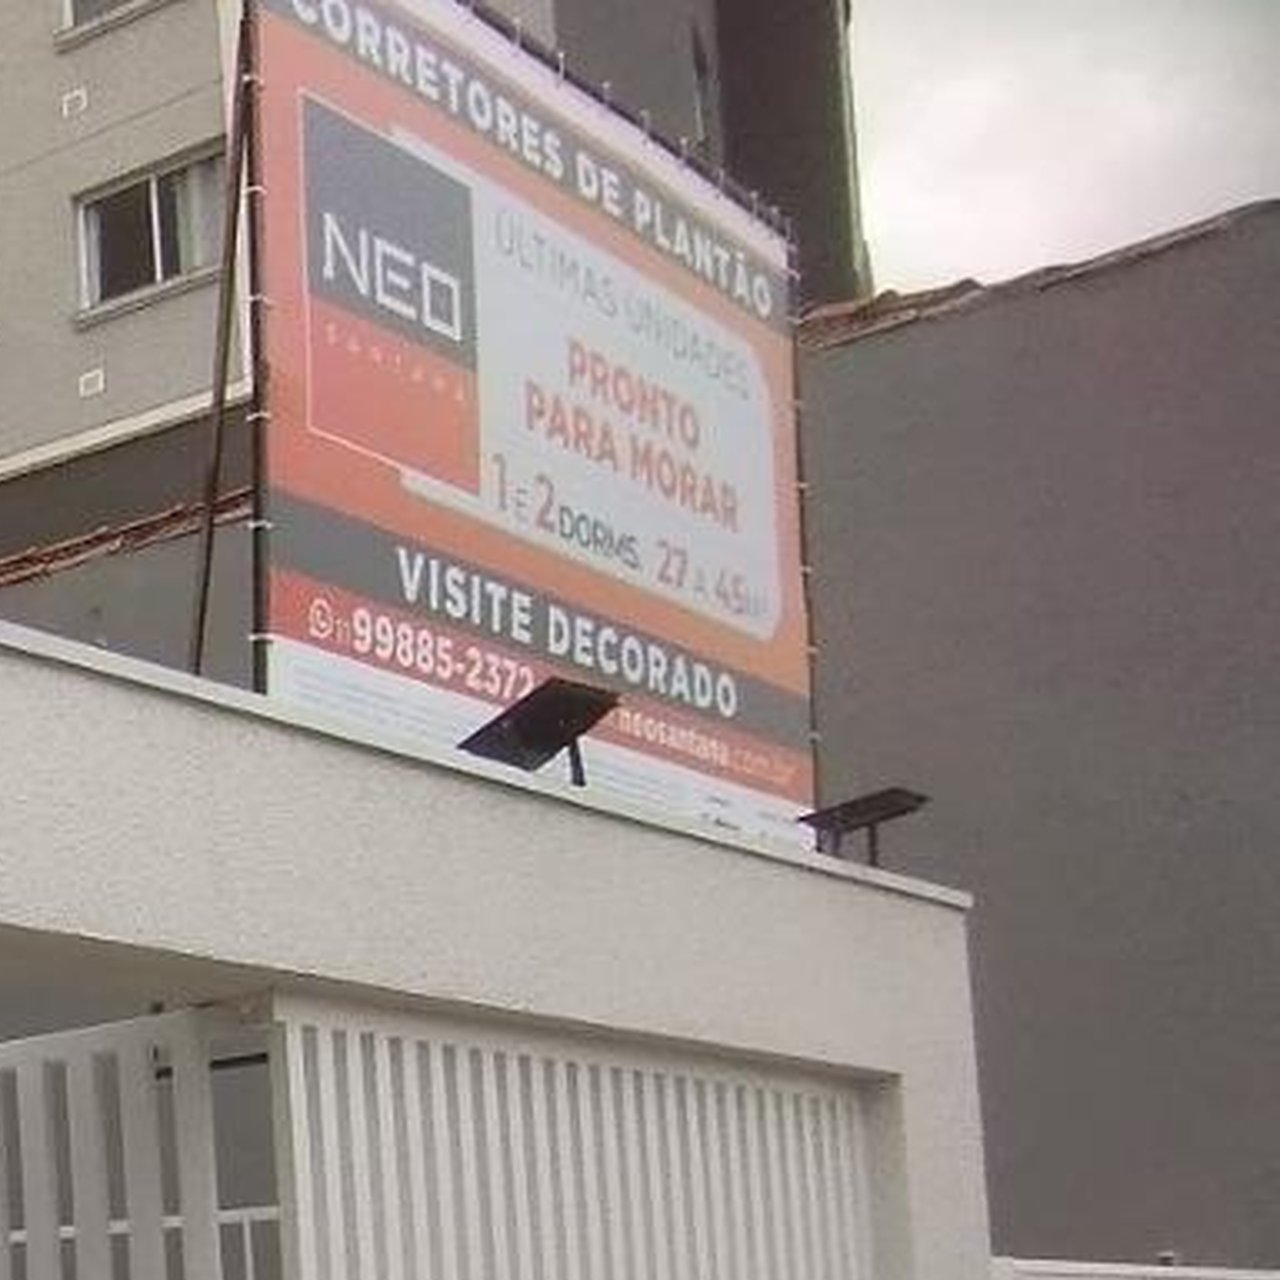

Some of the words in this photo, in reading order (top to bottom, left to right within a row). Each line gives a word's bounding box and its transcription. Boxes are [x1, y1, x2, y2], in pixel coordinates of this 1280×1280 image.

[322, 211, 462, 342] NEO
[576, 152, 622, 216] DE
[634, 188, 773, 320] PLANTÃO
[524, 377, 618, 473] PARA
[631, 434, 740, 533] MORAR
[566, 338, 700, 450] PRONTO
[656, 538, 689, 588] 27
[352, 607, 534, 698] 99885-2372
[397, 546, 534, 645] VISITE
[547, 603, 738, 717] DECORADO
